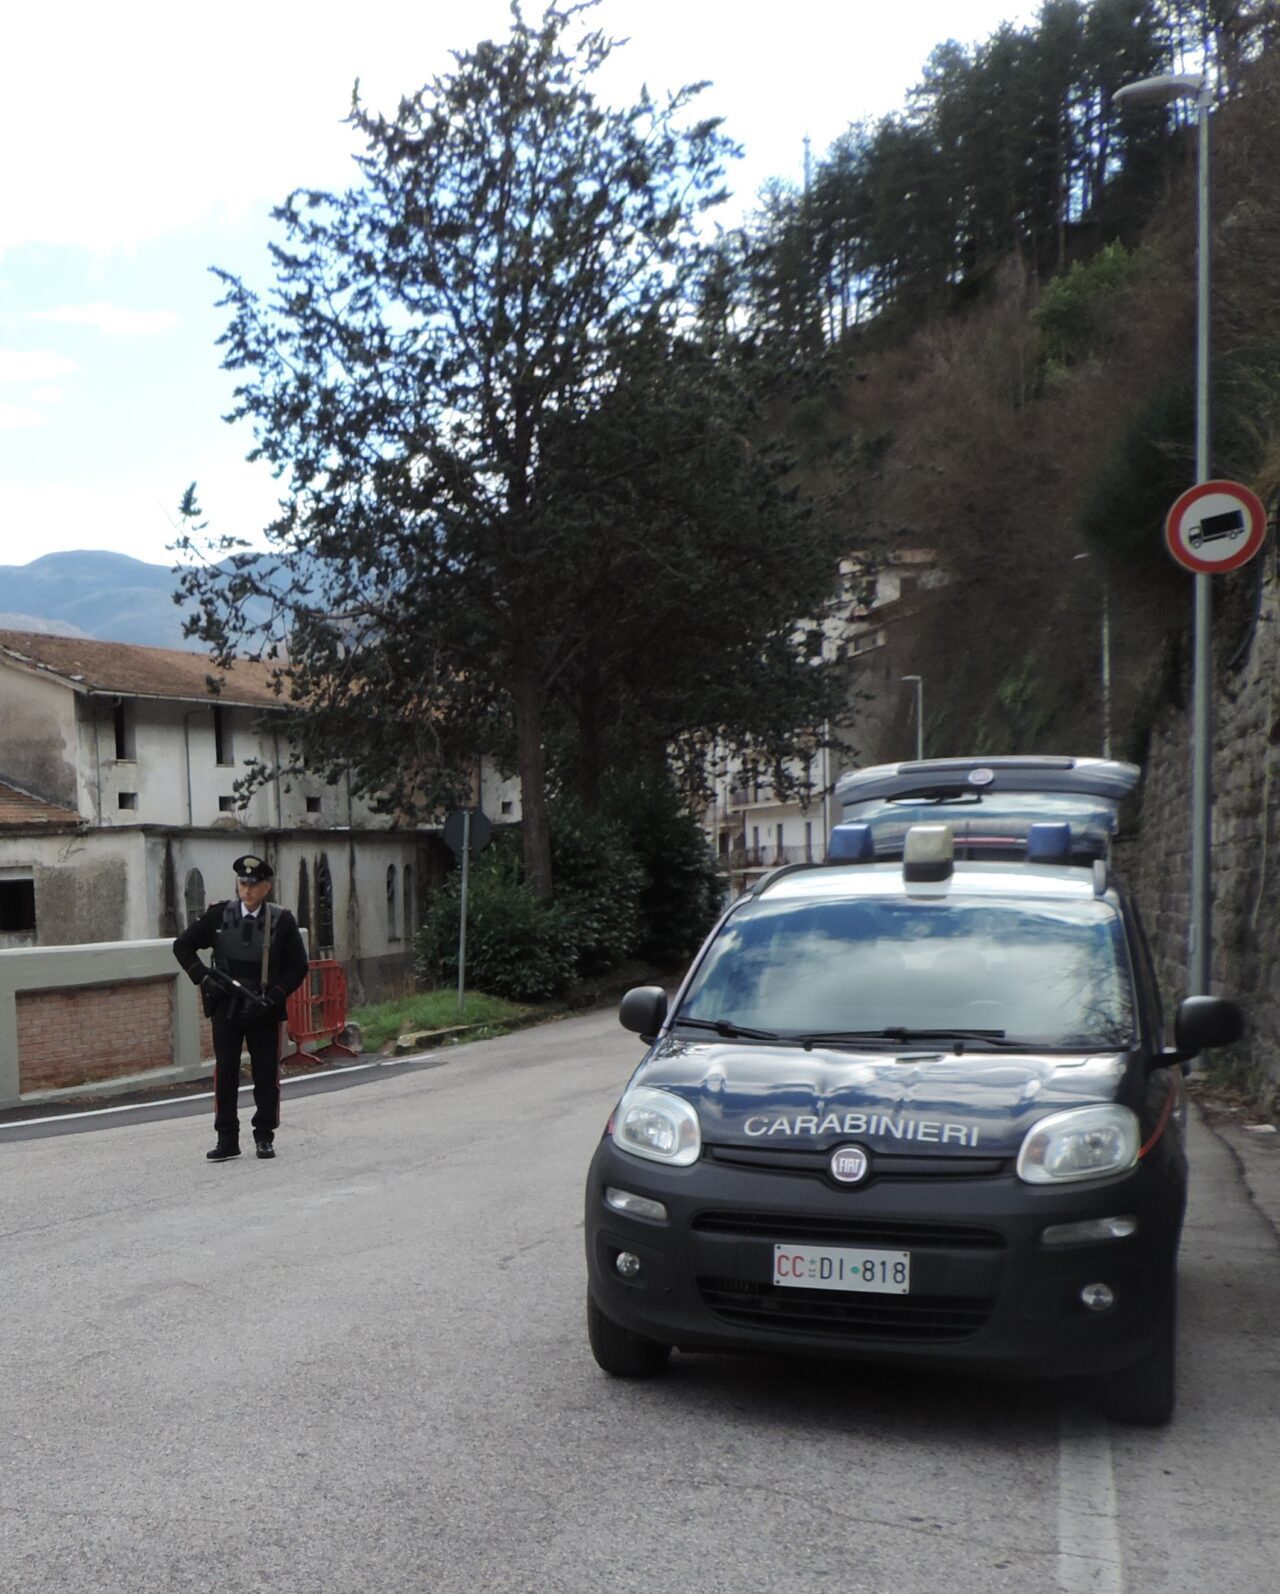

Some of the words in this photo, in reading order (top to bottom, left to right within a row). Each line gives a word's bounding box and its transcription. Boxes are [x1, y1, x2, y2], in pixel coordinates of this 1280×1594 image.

[744, 1113, 980, 1147] CARABINIERI
[839, 1157, 862, 1174] FIAT
[777, 1254, 805, 1278] CC
[820, 1257, 844, 1281] DI
[862, 1259, 906, 1284] 818
